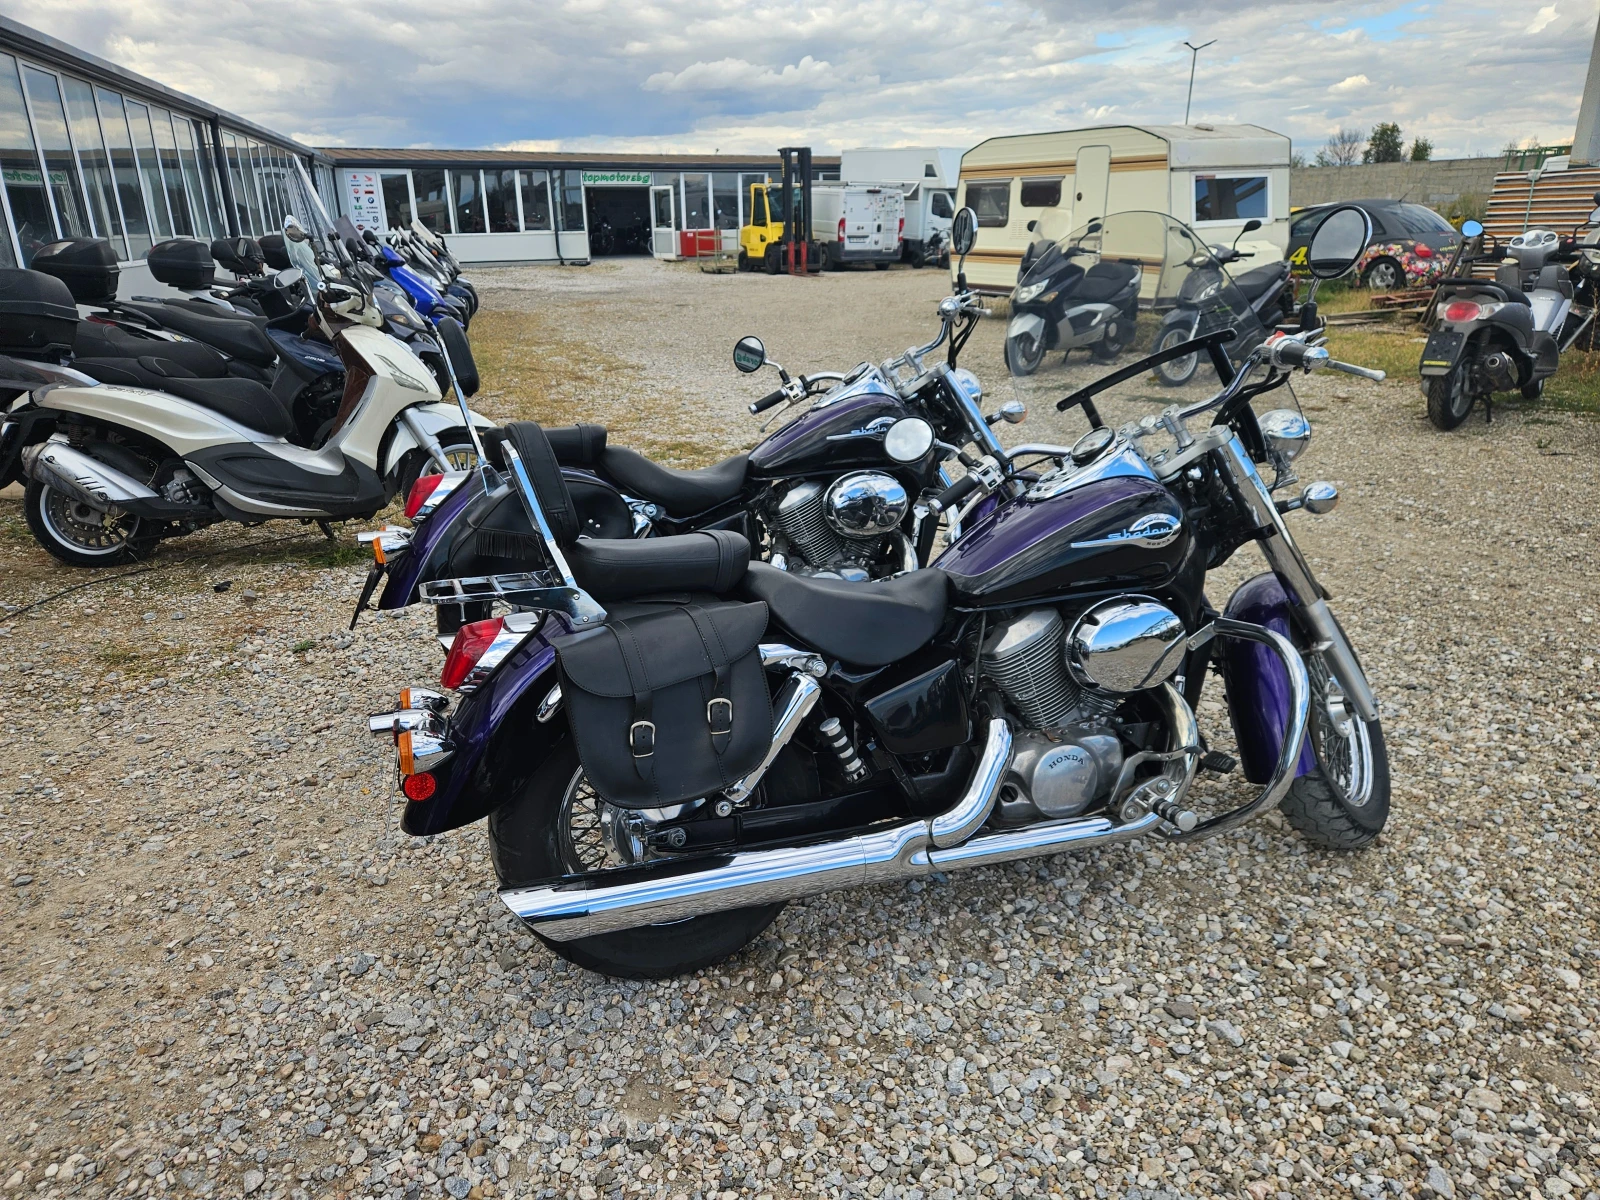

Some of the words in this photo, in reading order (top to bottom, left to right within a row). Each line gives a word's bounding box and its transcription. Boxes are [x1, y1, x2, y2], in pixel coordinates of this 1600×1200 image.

[583, 171, 650, 184] topmotorsbg
[851, 424, 887, 434] Shado
[1107, 525, 1170, 539] Shadow
[1048, 754, 1085, 769] HONDA
